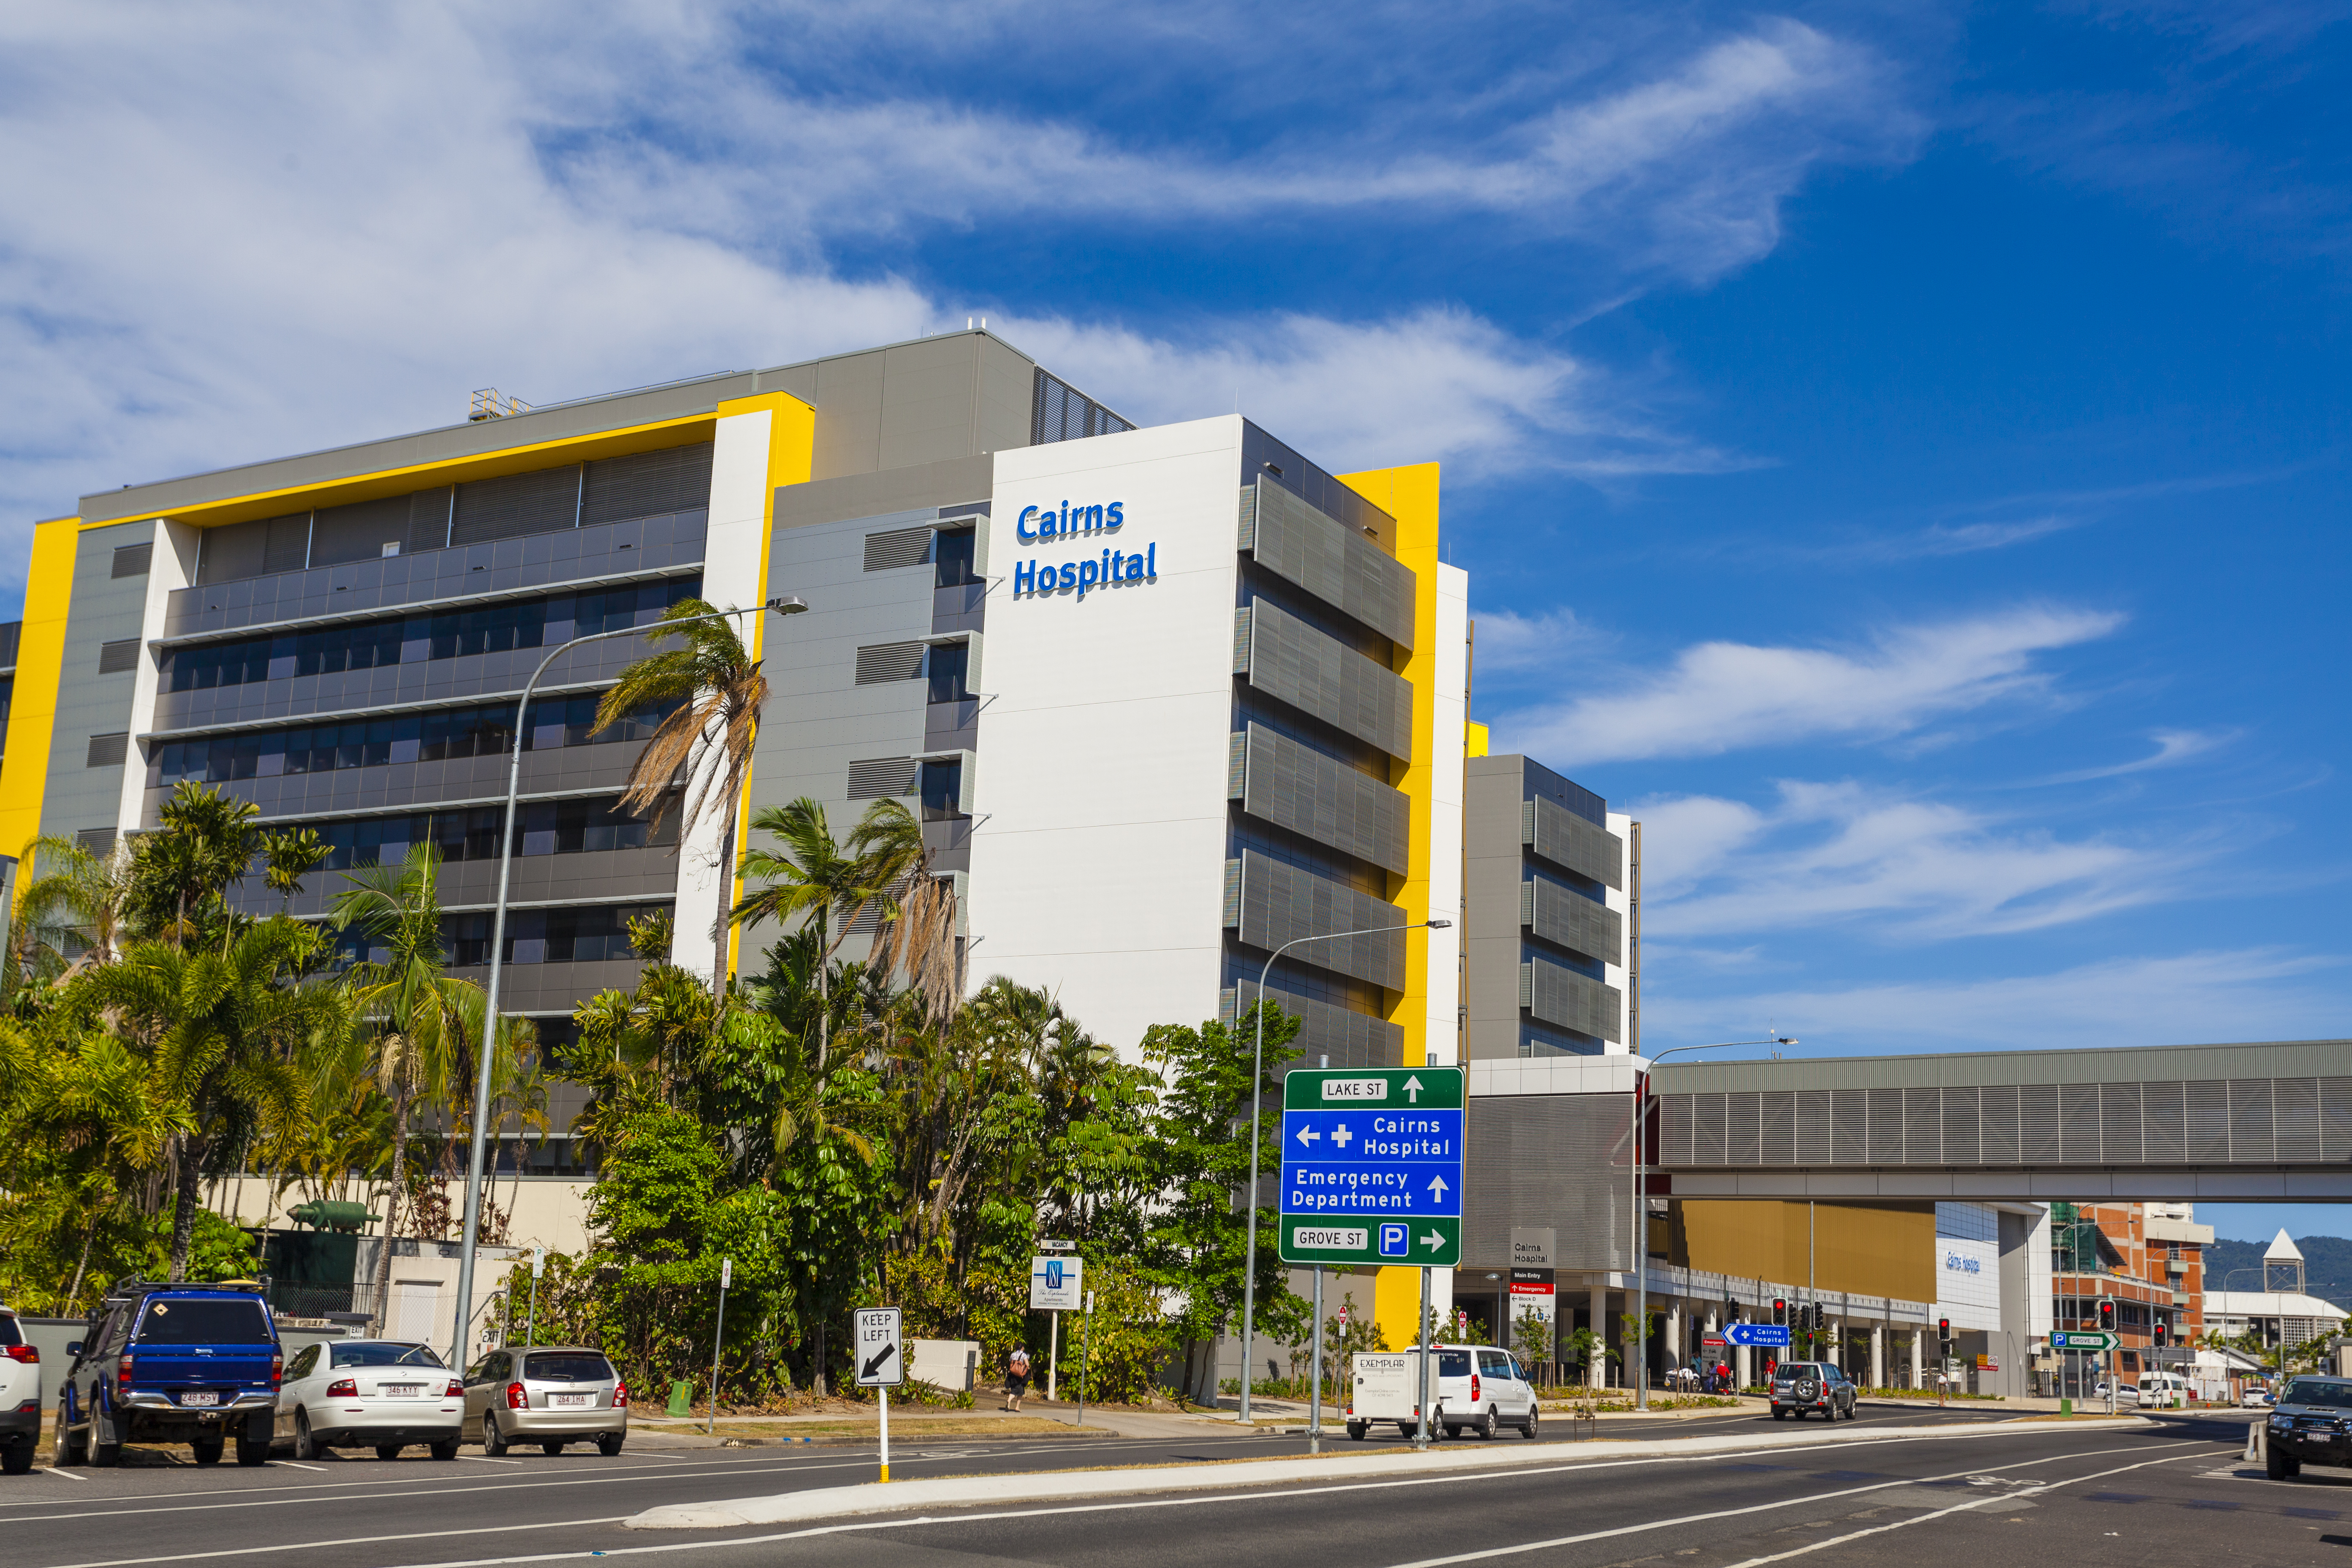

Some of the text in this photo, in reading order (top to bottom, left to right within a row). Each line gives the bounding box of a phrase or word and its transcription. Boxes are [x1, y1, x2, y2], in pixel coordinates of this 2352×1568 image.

[1018, 500, 1124, 539] Cairns
[1015, 542, 1157, 596] Hospital
[1328, 1083, 1382, 1095] LAKE ST
[1374, 1117, 1440, 1133] Cairns
[1364, 1139, 1449, 1158] Hospital
[1297, 1169, 1408, 1189] Emergency
[1293, 1190, 1412, 1210] Department
[1299, 1232, 1362, 1245] GROVE ST
[1385, 1228, 1403, 1252] P
[1515, 1243, 1541, 1251] Cairns
[1515, 1254, 1548, 1264] Hospital
[1947, 1251, 1980, 1274] Cairns Hospital
[1048, 1262, 1059, 1287] 181
[1048, 1289, 1069, 1297] Esplanade
[863, 1314, 891, 1326] KEEP
[483, 1331, 499, 1342] EXIT
[864, 1330, 890, 1341] LEFT
[2055, 1334, 2064, 1345] P
[487, 1344, 494, 1353] NO
[1360, 1359, 1405, 1367] EXEMPLAR
